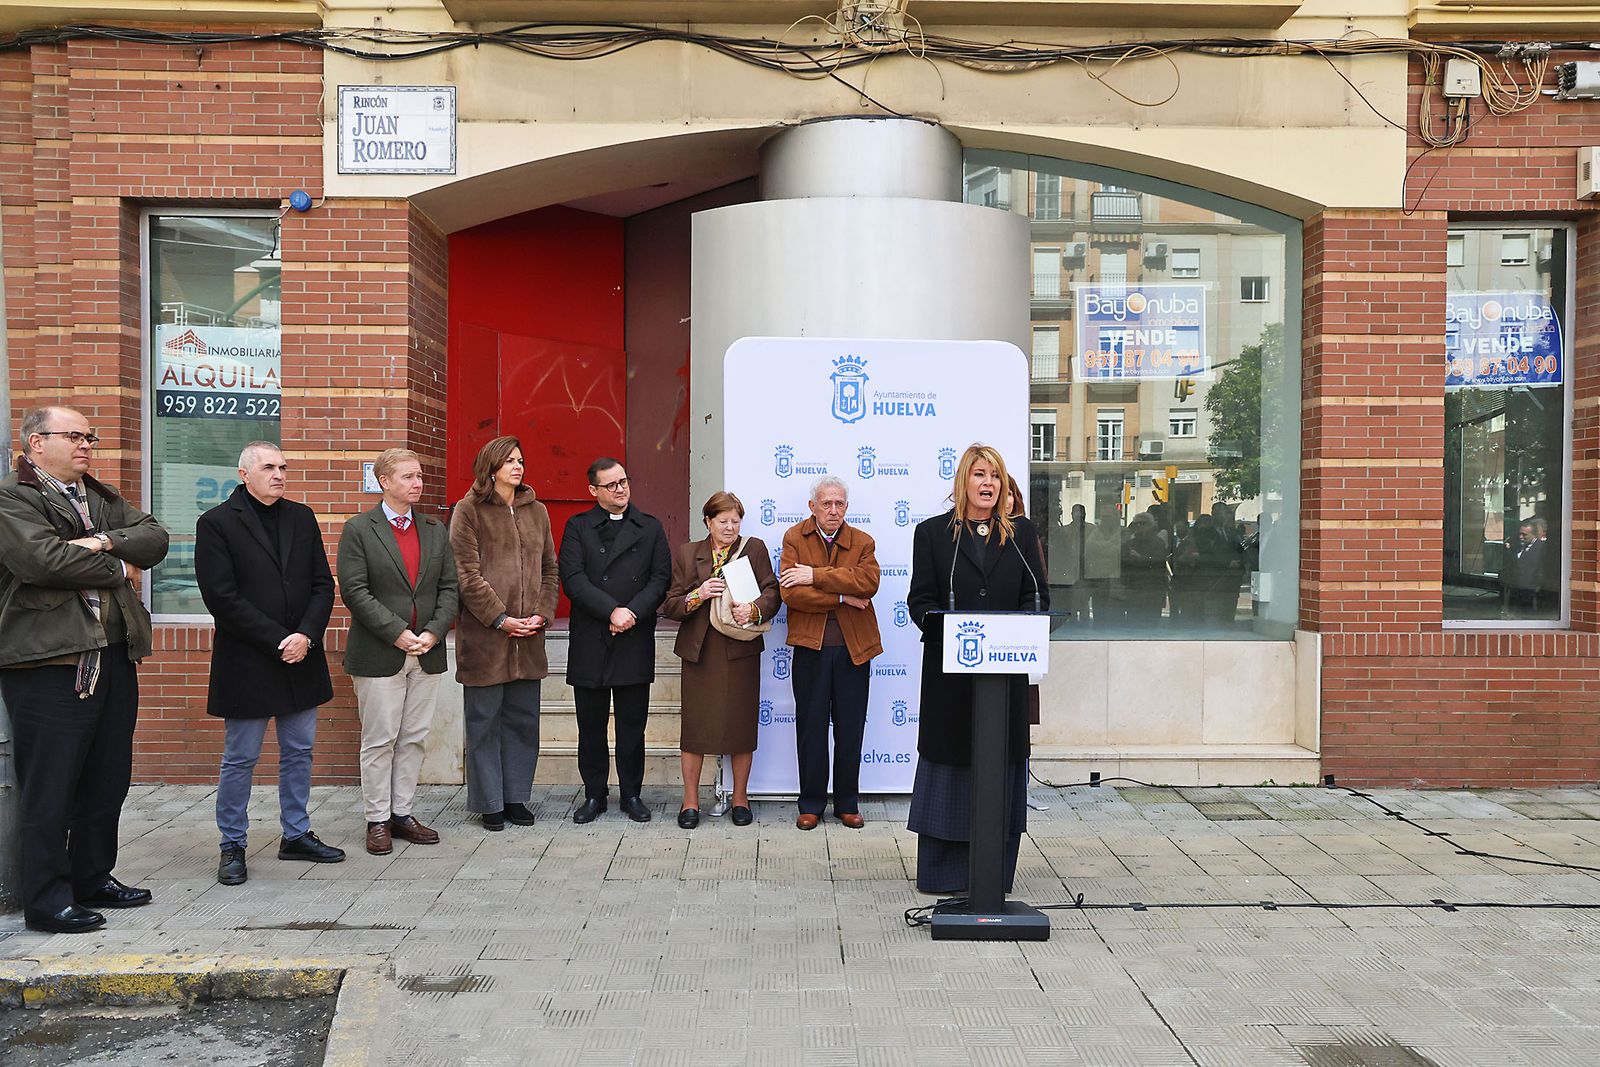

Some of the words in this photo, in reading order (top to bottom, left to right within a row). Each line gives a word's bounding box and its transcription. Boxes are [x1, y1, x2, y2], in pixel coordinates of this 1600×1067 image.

[352, 112, 399, 136] JUAN
[353, 139, 427, 162] ROMERO
[1108, 329, 1177, 346] VENDE
[1463, 336, 1534, 354] VENDE
[208, 346, 281, 358] INMOBILIARIA
[1084, 350, 1119, 368] 959
[1124, 350, 1145, 368] 87
[1151, 350, 1173, 368] 04
[1480, 357, 1502, 375] 87
[1507, 355, 1530, 374] 04
[1534, 355, 1557, 374] 90
[161, 364, 281, 389] ALQUILA
[873, 390, 926, 400] Ayuntamiento
[927, 391, 937, 400] de
[164, 395, 197, 413] 959
[204, 396, 237, 414] 822
[245, 398, 280, 416] 522
[873, 402, 936, 416] HUELVA
[795, 467, 828, 475] HUELVA
[878, 468, 909, 476] HUELVA
[988, 652, 1037, 662] HUELVA
[875, 668, 907, 676] HUELVA
